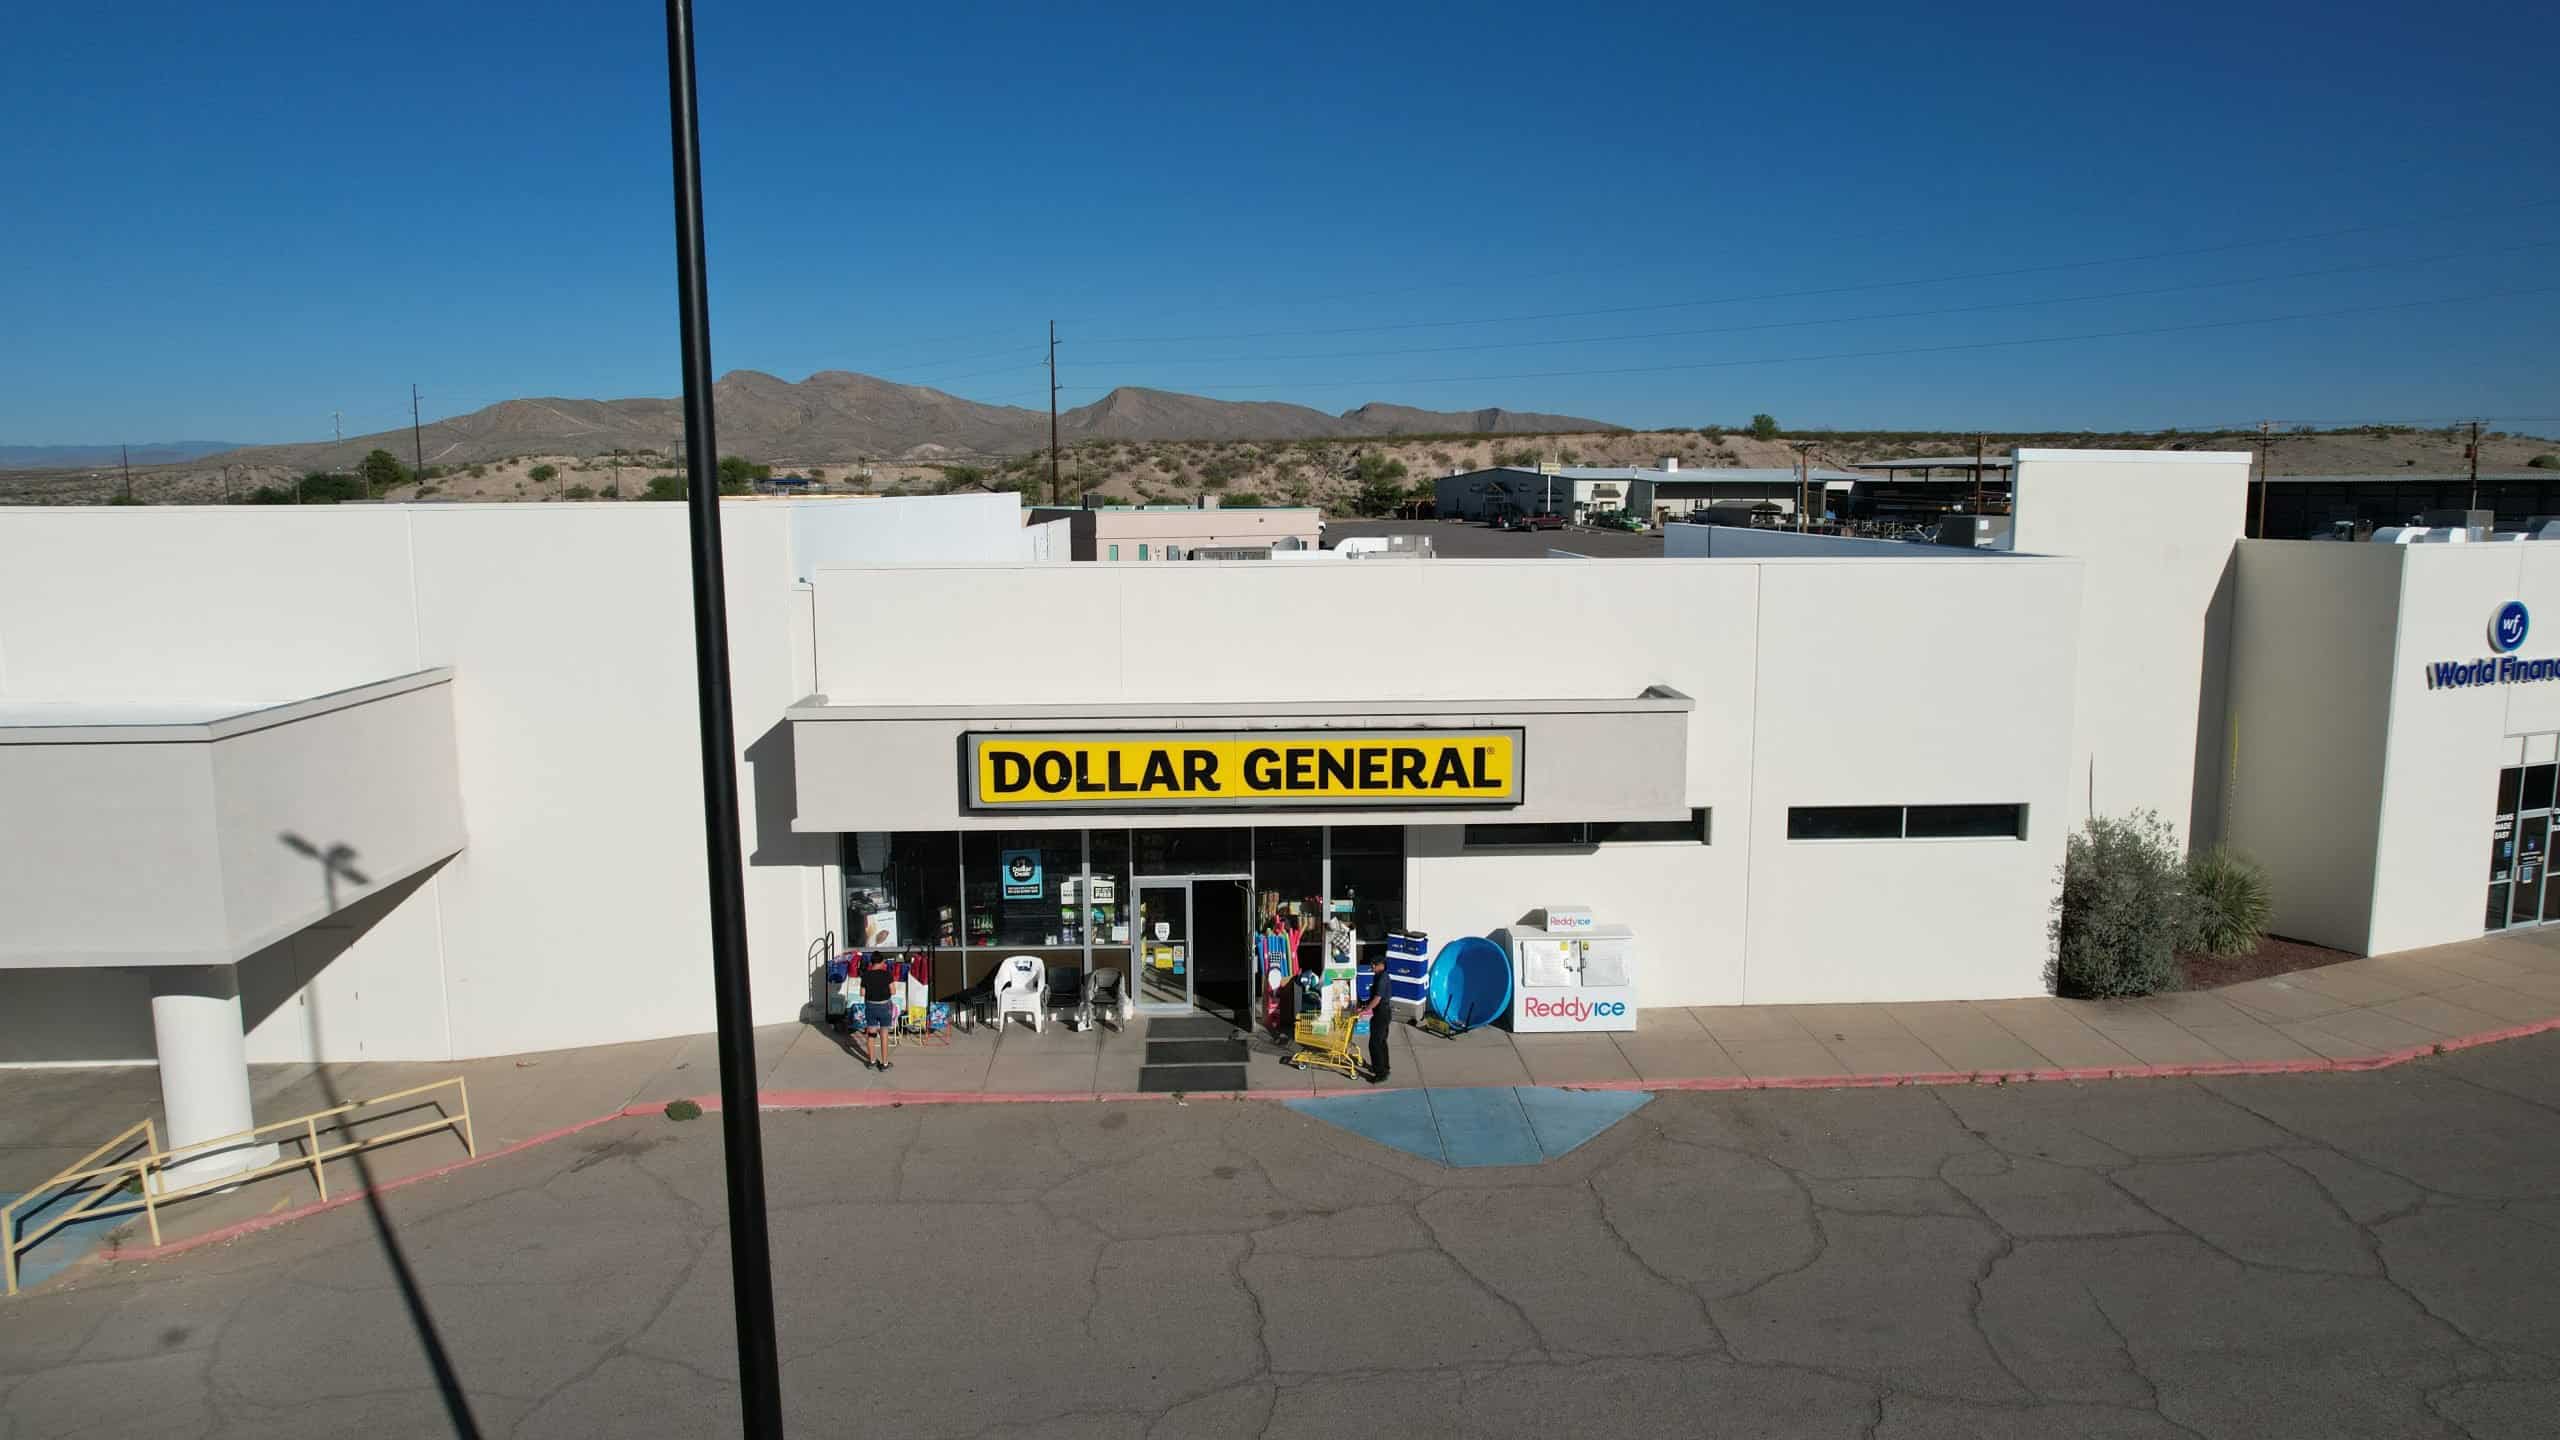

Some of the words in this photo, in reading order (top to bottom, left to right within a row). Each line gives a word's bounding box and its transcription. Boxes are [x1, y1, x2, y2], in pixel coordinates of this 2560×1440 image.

[2503, 614, 2521, 634] wf
[2434, 658, 2497, 687] World
[989, 750, 1221, 793] DOLLAR
[1243, 747, 1502, 790] GENERAL
